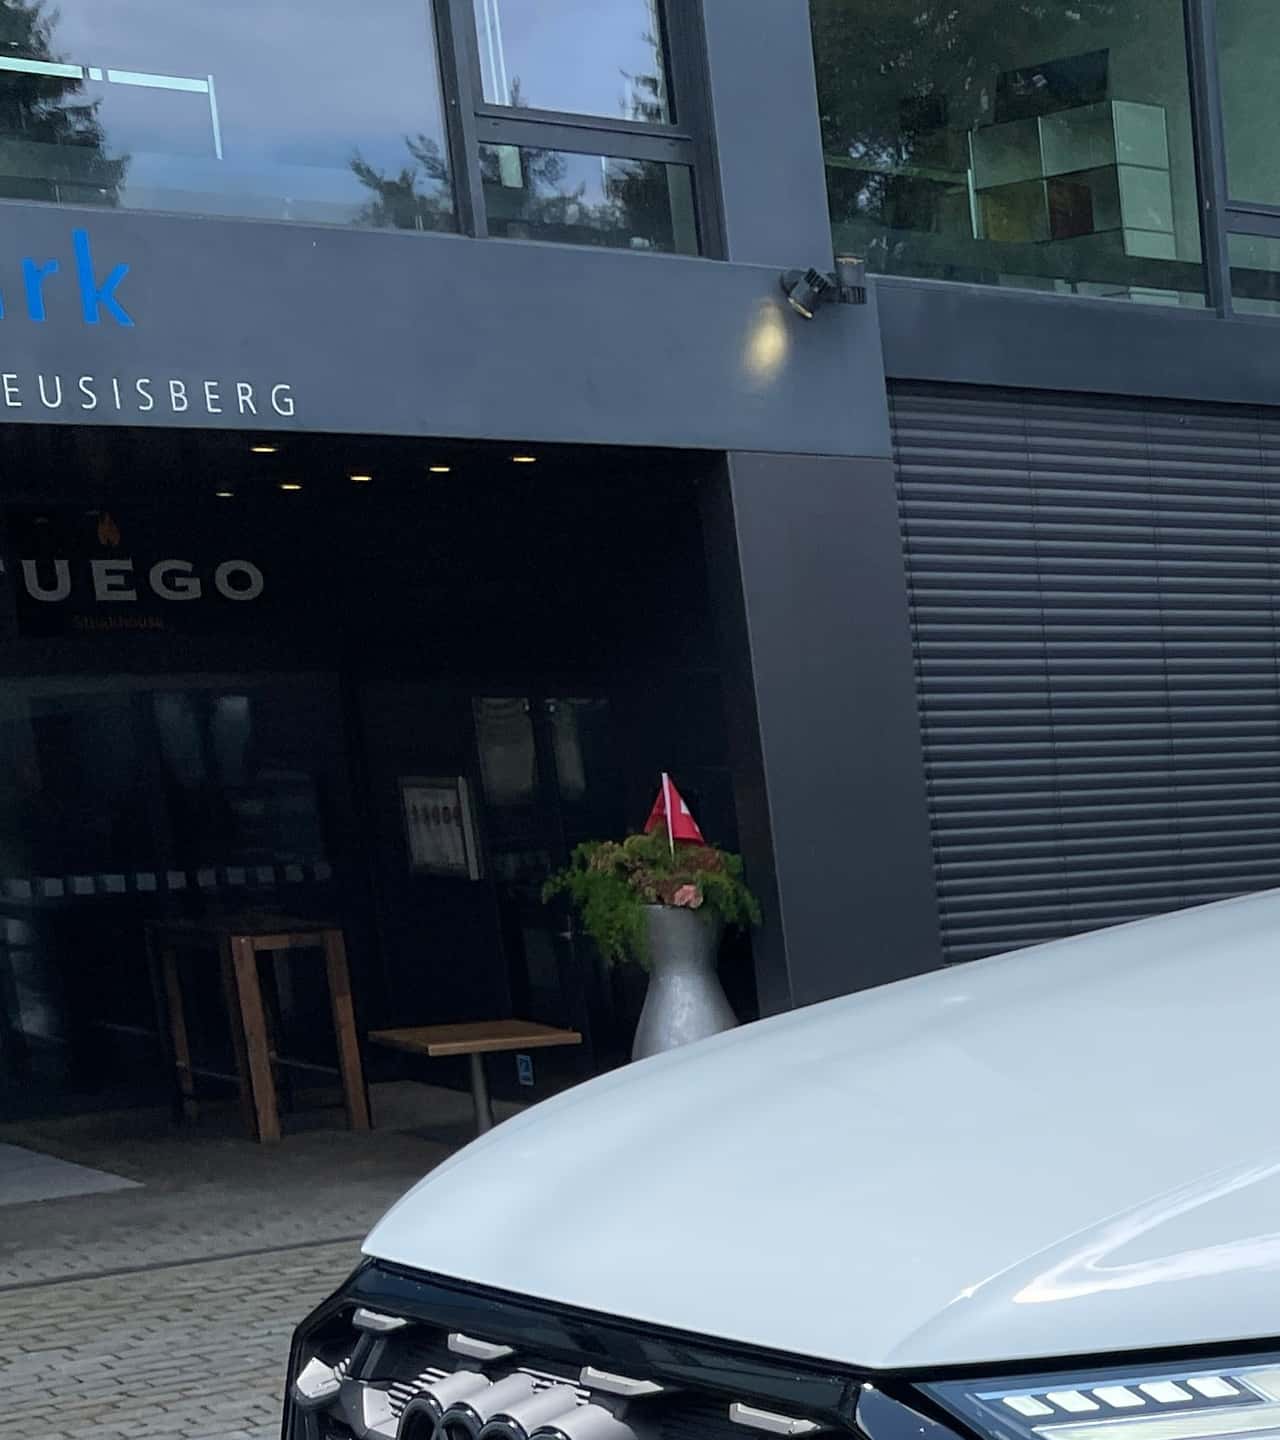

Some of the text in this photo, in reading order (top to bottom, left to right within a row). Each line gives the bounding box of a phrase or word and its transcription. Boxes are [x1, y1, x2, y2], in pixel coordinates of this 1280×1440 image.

[0, 227, 135, 327] rk
[1, 373, 296, 416] EUSISBERG
[0, 559, 264, 602] UEGO
